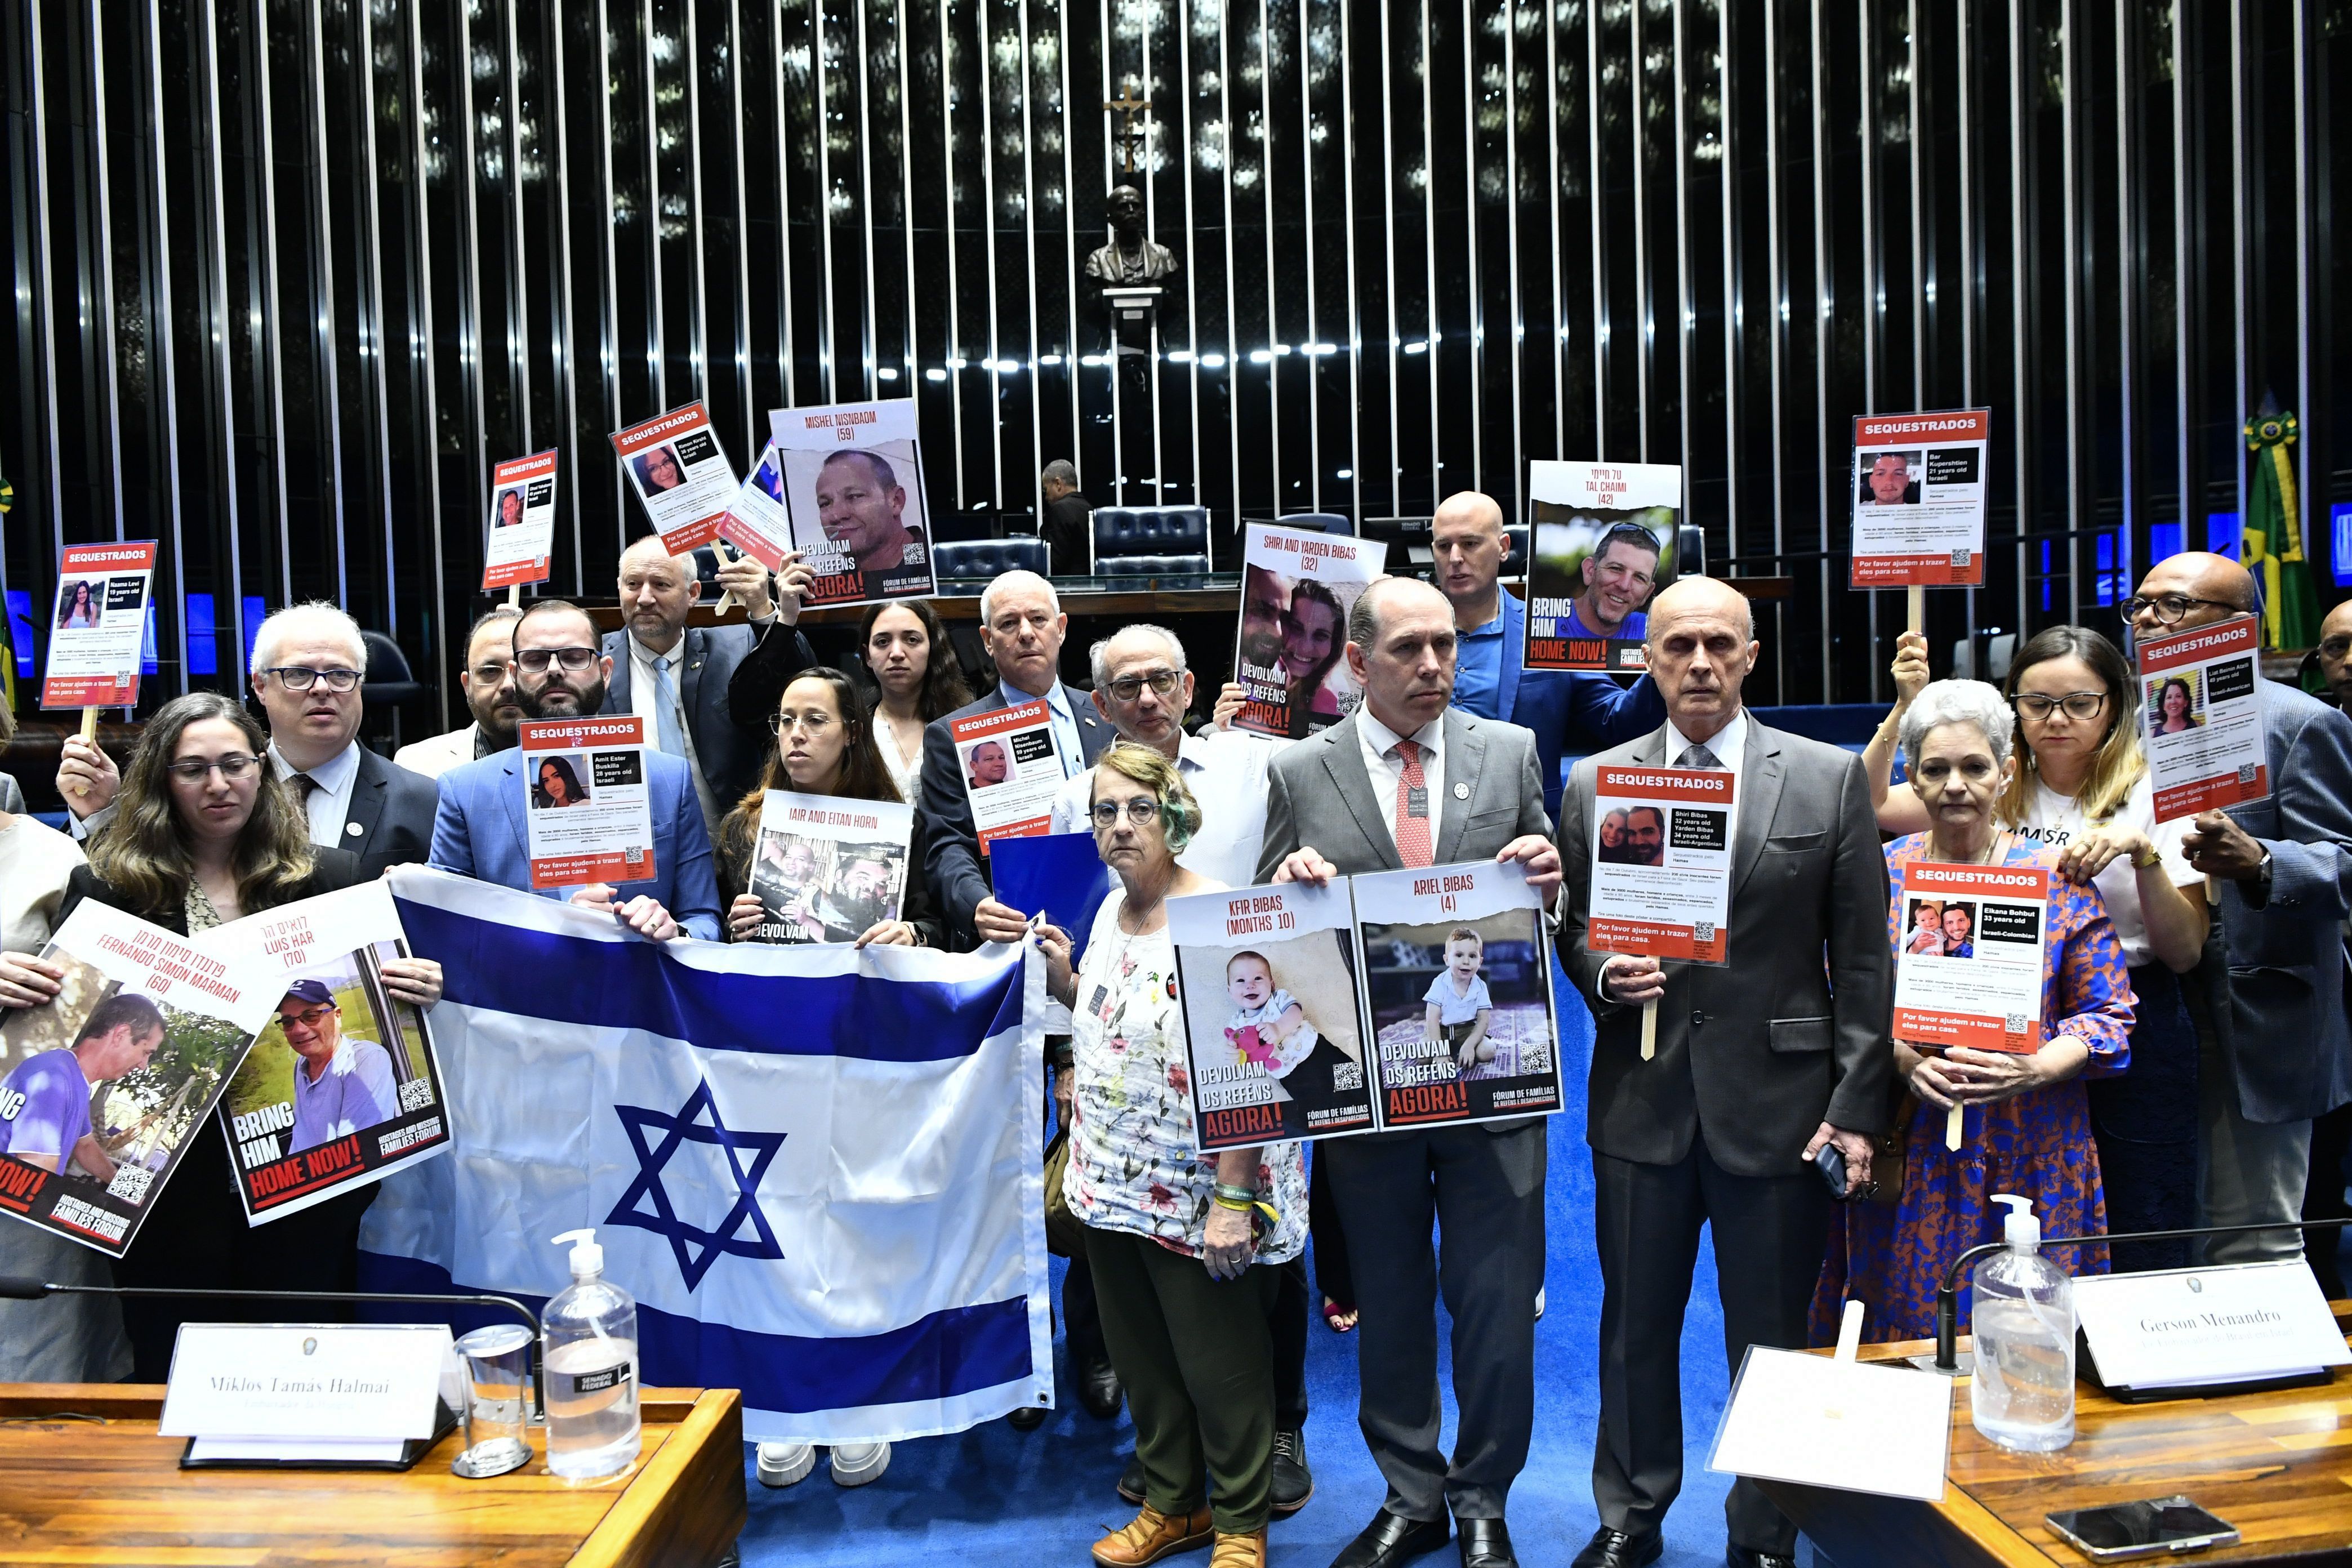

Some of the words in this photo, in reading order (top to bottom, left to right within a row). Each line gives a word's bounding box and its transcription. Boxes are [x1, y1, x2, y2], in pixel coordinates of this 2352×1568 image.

[622, 411, 698, 446] SEQUESTRADOS
[805, 415, 834, 429] MISHEL
[835, 411, 876, 426] NISNBAOM
[1865, 418, 1976, 434] SEQUESTRADOS
[838, 427, 854, 442] (59)
[500, 457, 551, 476] SEQUESTRADOS
[1585, 481, 1598, 492] TAL
[1600, 482, 1627, 492] CHAIMI
[1598, 494, 1613, 505] (42)
[69, 550, 146, 563] SEQUESTRADOS
[1264, 535, 1283, 550] SHIRI
[1284, 538, 1299, 553] AND
[1301, 541, 1330, 556] YARDEN
[1331, 545, 1356, 560] BIBAS
[818, 556, 855, 572] REFÉNS
[1302, 556, 1317, 572] (32)
[809, 571, 864, 597] GORA!
[908, 576, 930, 584] FAMÍLIAS
[1532, 598, 1571, 617] BRING
[1531, 618, 1556, 638] HIM
[1530, 640, 1565, 660] HOME
[1569, 639, 1607, 661] NOW!
[2148, 627, 2247, 661] SEQUESTRADOS
[1620, 656, 1645, 665] FAMILIE
[1242, 663, 1286, 684] DEVOLVAM
[1241, 681, 1251, 696] OS
[1253, 685, 1286, 703] REFÉNS
[958, 707, 1041, 732] SEQUESTRADOS
[530, 724, 634, 739] SEQUESTRADOS
[1015, 740, 1043, 749] Nisenbaum
[1607, 774, 1724, 790] SEQUESTRADOS
[789, 808, 806, 822] IAIR
[808, 810, 826, 823] AND
[828, 812, 851, 826] EITAN
[854, 815, 877, 829] HORN
[1414, 878, 1441, 896] ARIEL
[1444, 875, 1473, 893] BIBAS
[1916, 870, 2037, 887] SEQUESTRADOS
[1228, 899, 1250, 917] KFIR
[1253, 895, 1282, 914] BIBAS
[1441, 894, 1456, 914] (4)
[1227, 915, 1272, 937] (MONTHS
[1277, 911, 1294, 929] 10)
[1983, 930, 2035, 939] Israeli-Colombian
[265, 938, 289, 955] LUIS
[291, 932, 314, 947] HAR
[97, 934, 155, 966] FERNANDO
[154, 958, 191, 982] SIMON
[189, 973, 240, 1003] MARMAN
[284, 949, 306, 968] (70)
[145, 973, 172, 995] (60)
[1383, 1040, 1451, 1062] DEVOLVAM
[1200, 1061, 1266, 1085] DEVOLVAM
[1386, 1068, 1404, 1084] OS
[1407, 1062, 1456, 1083] REFÉNS
[1202, 1091, 1220, 1108] OS
[1224, 1083, 1272, 1102] REFÉNS
[1389, 1081, 1467, 1115] AGORA!
[1493, 1090, 1515, 1101] FÓRUM
[1517, 1089, 1525, 1098] DE
[1526, 1086, 1554, 1097] FAMÍLIAS
[1521, 1095, 1556, 1104] DESAPARECIDOS
[232, 1101, 296, 1143] BRING
[1206, 1102, 1282, 1138] AGORA!
[1307, 1110, 1329, 1120] FÓRUM
[1330, 1108, 1339, 1117] DE
[1340, 1104, 1368, 1116] FAMÍLIAS
[1335, 1113, 1369, 1123] DESAPARECIDOS
[378, 1128, 406, 1144] HOSTAGES
[406, 1125, 416, 1134] AND
[416, 1116, 439, 1130] MISSING
[380, 1134, 415, 1155] FAMILIES
[415, 1124, 442, 1143] FORUM
[240, 1135, 282, 1170] HIM
[248, 1157, 306, 1199] HOME
[306, 1135, 361, 1178] NOW!
[59, 1194, 92, 1213] HOSTAGES
[89, 1206, 104, 1218] AND
[103, 1211, 131, 1228] MISSING
[52, 1203, 94, 1229] FAMILIES
[91, 1219, 126, 1241] FORUM
[2140, 1318, 2197, 1333] Gerson
[2200, 1309, 2281, 1328] Menandro
[211, 1377, 262, 1392] Miklos
[329, 1379, 389, 1393] Halmai
[582, 1380, 612, 1391] FEDERAL
